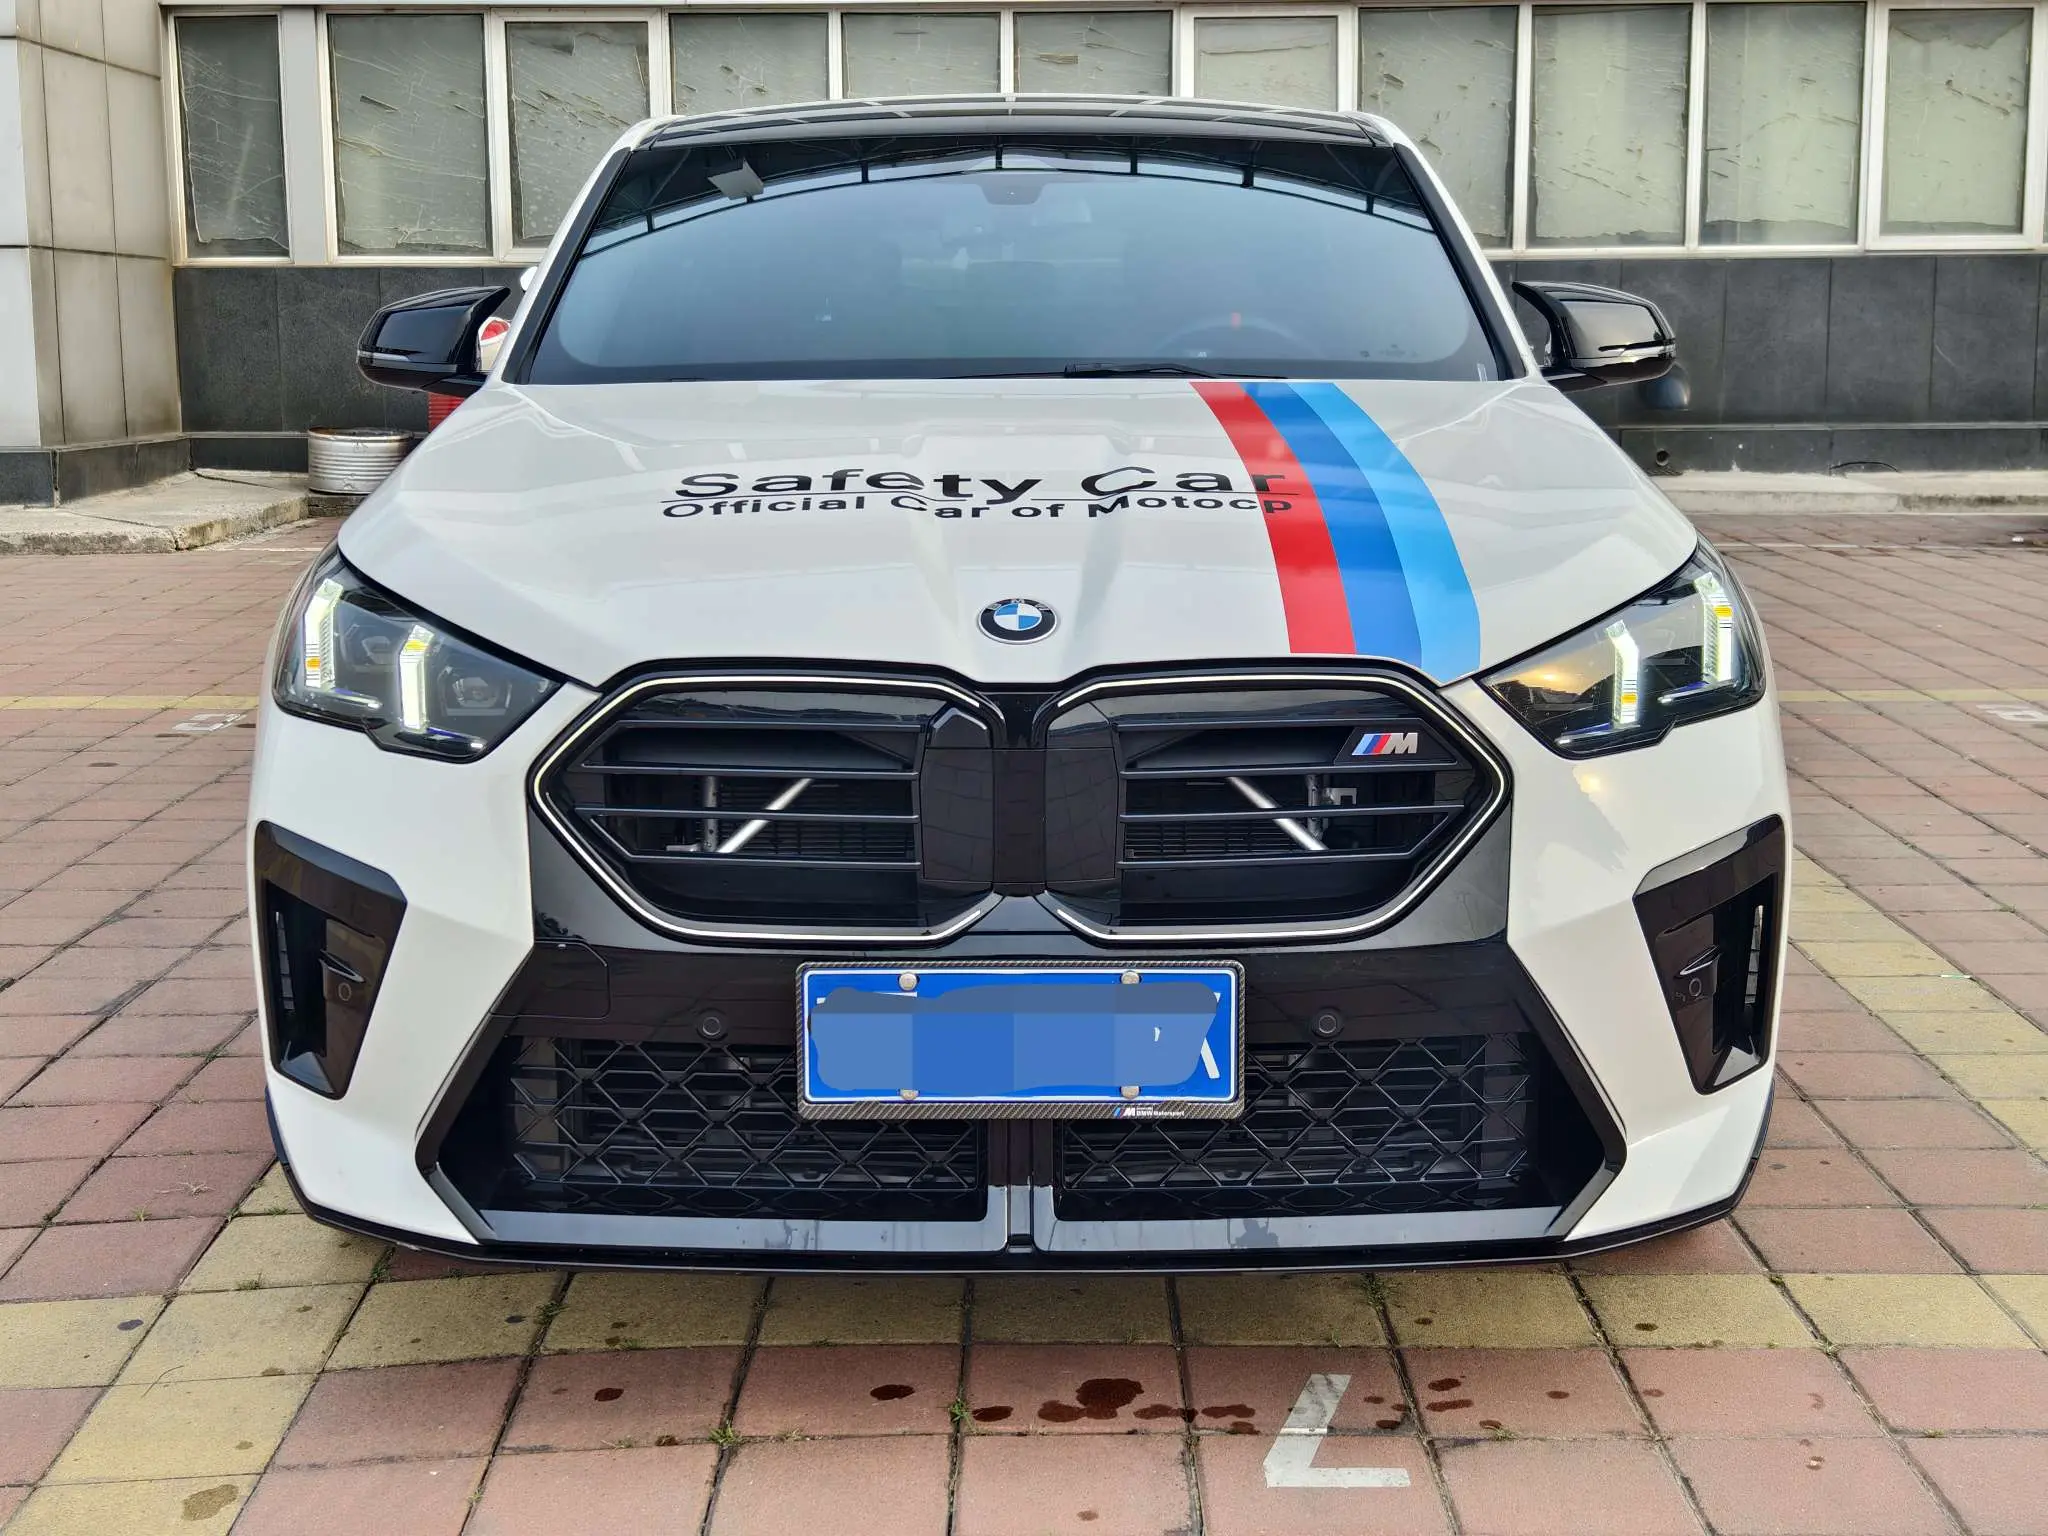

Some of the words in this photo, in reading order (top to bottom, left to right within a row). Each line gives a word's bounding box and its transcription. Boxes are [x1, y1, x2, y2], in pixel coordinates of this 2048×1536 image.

[676, 468, 1042, 505] Safety
[1081, 466, 1286, 496] Car
[663, 496, 865, 518] Official
[891, 495, 990, 519] Car
[1011, 503, 1065, 518] of
[1380, 732, 1418, 755] M
